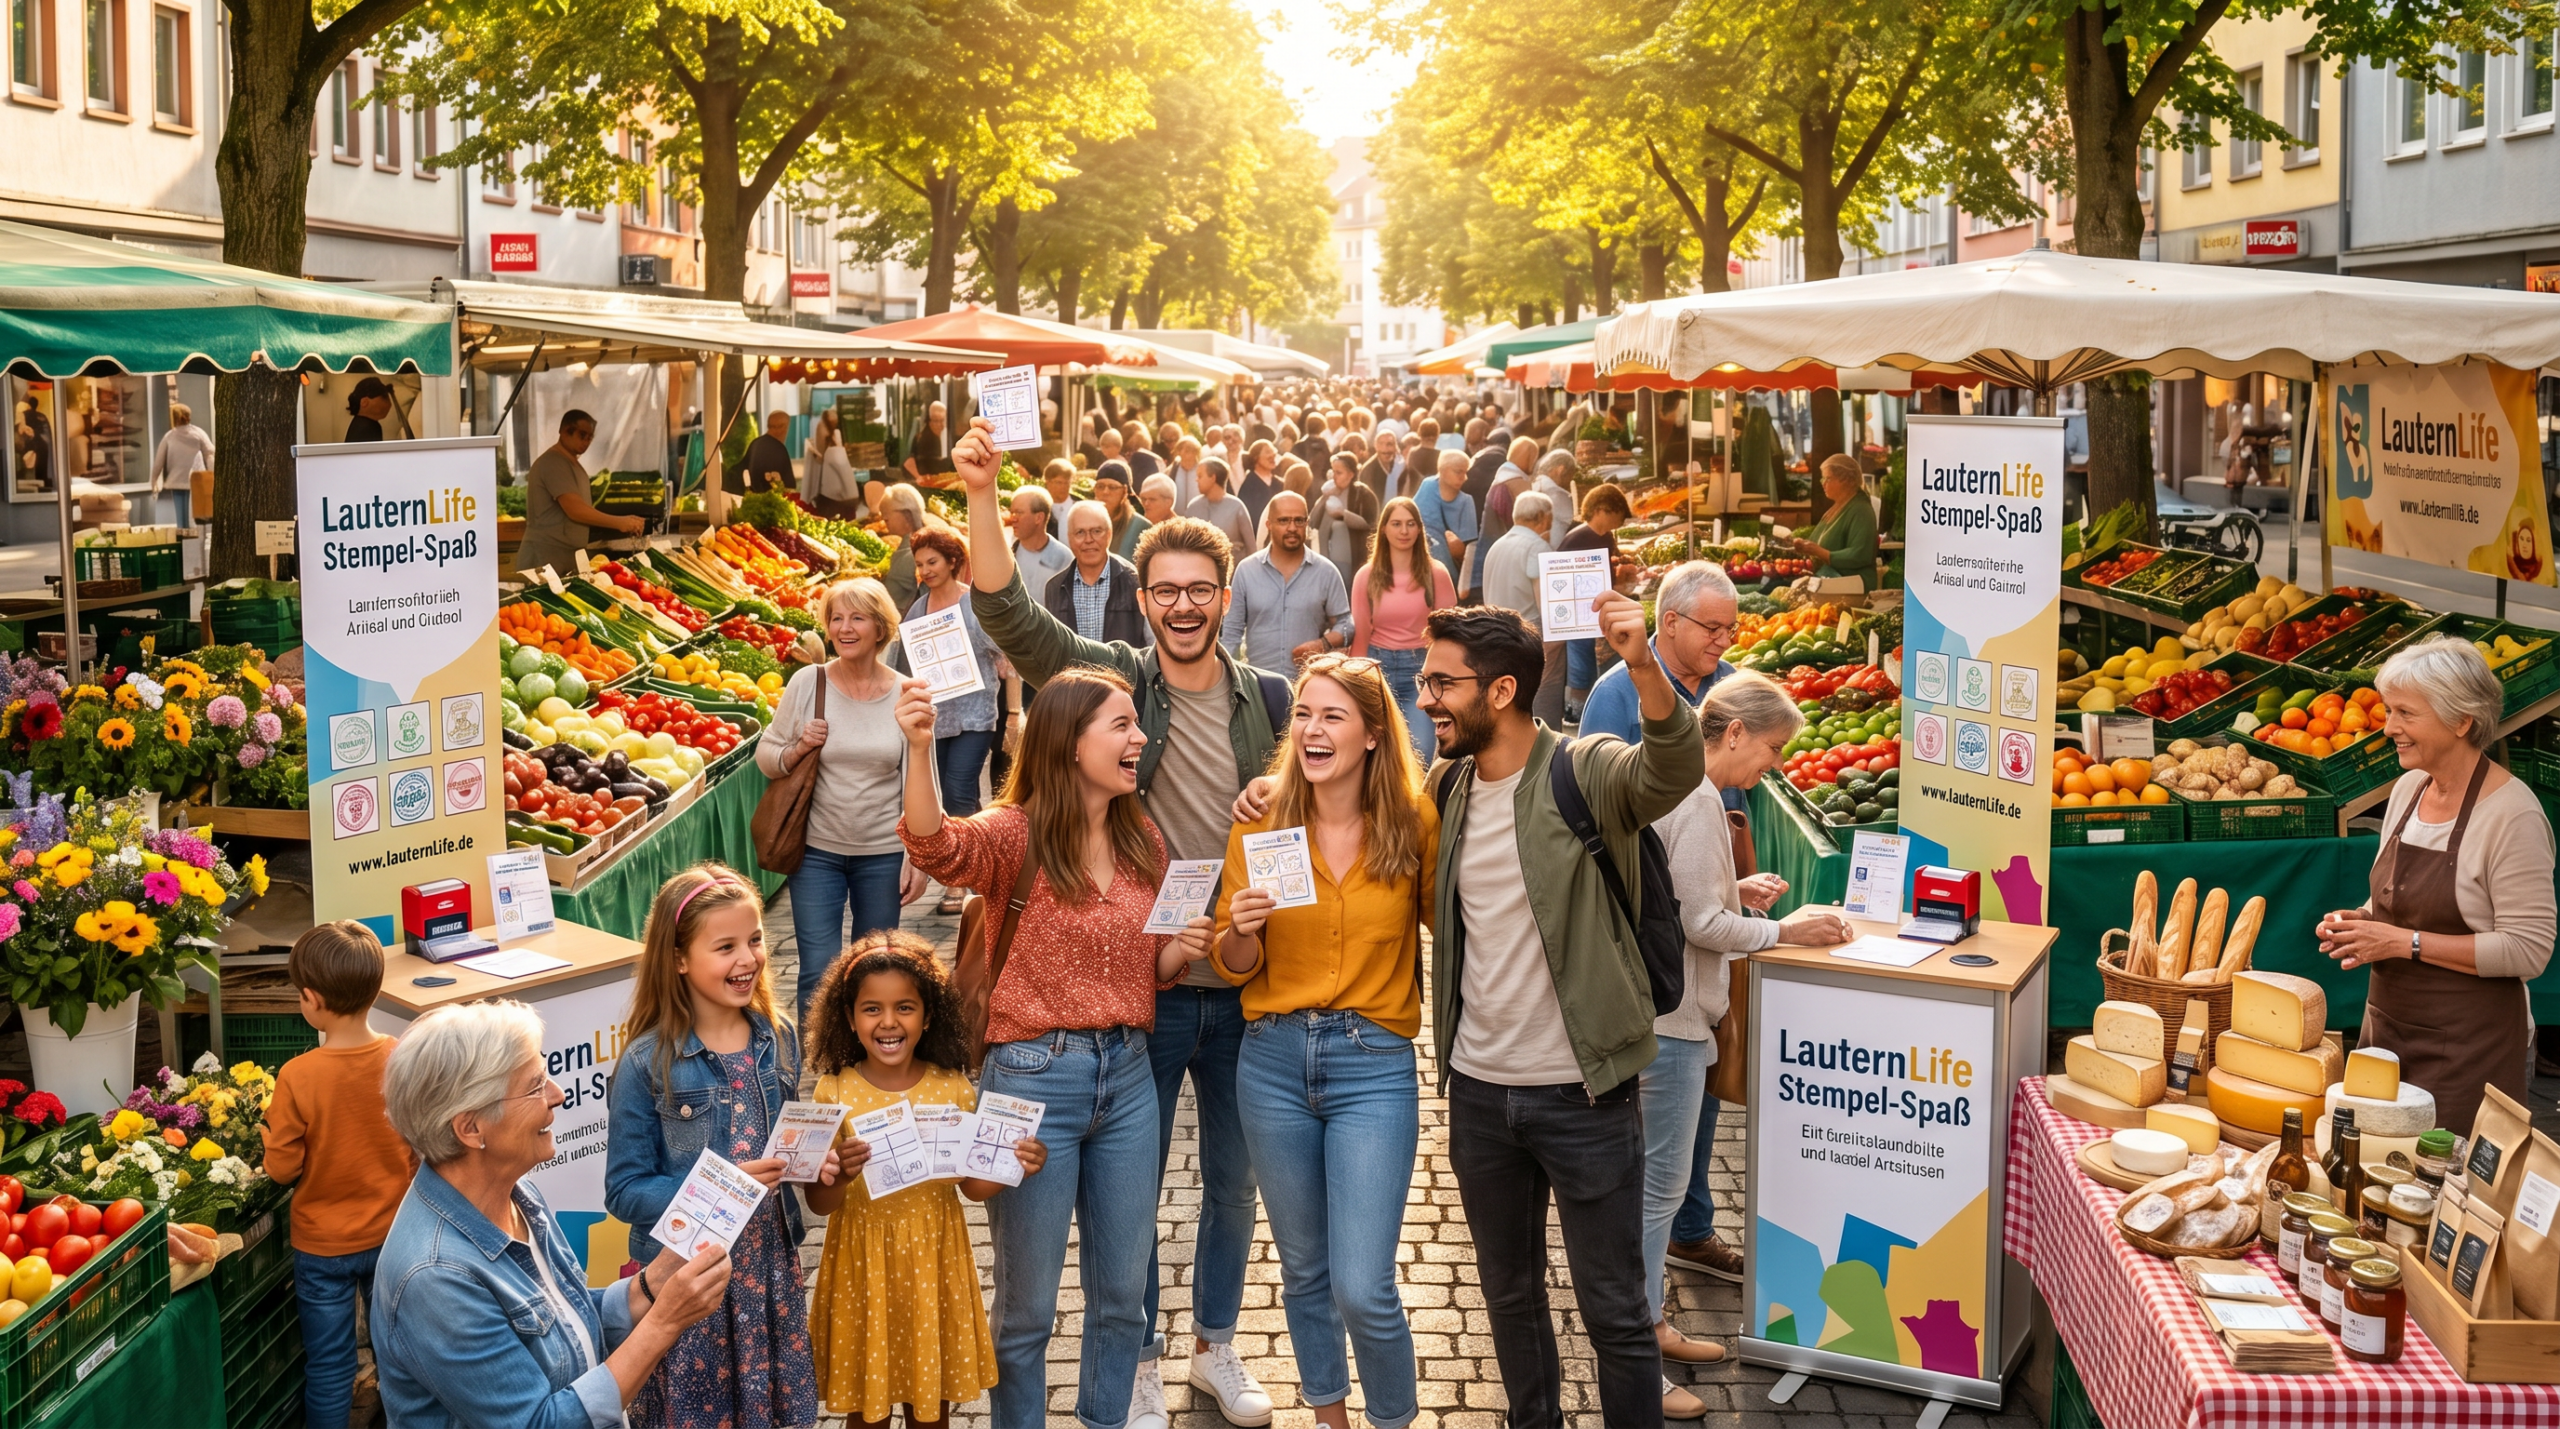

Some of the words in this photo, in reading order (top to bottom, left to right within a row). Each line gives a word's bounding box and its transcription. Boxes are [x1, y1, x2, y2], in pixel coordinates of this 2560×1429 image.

[2382, 407, 2499, 462] LauternLife
[1923, 459, 2043, 498] LauternLife
[322, 488, 476, 532] LauternLife
[1921, 499, 2042, 538] Stempel-Spaß
[323, 530, 477, 573] Stempel-Spaß
[1967, 577, 1985, 590] und
[392, 613, 414, 630] und
[1921, 784, 2021, 819] www.lauternLife.de
[349, 835, 473, 875] www.lauternLife.de
[541, 1023, 628, 1077] ernLif
[1780, 1029, 1973, 1088] LauternLife
[1779, 1073, 1971, 1129] Stempel-Spaß
[1801, 1147, 1826, 1161] und
